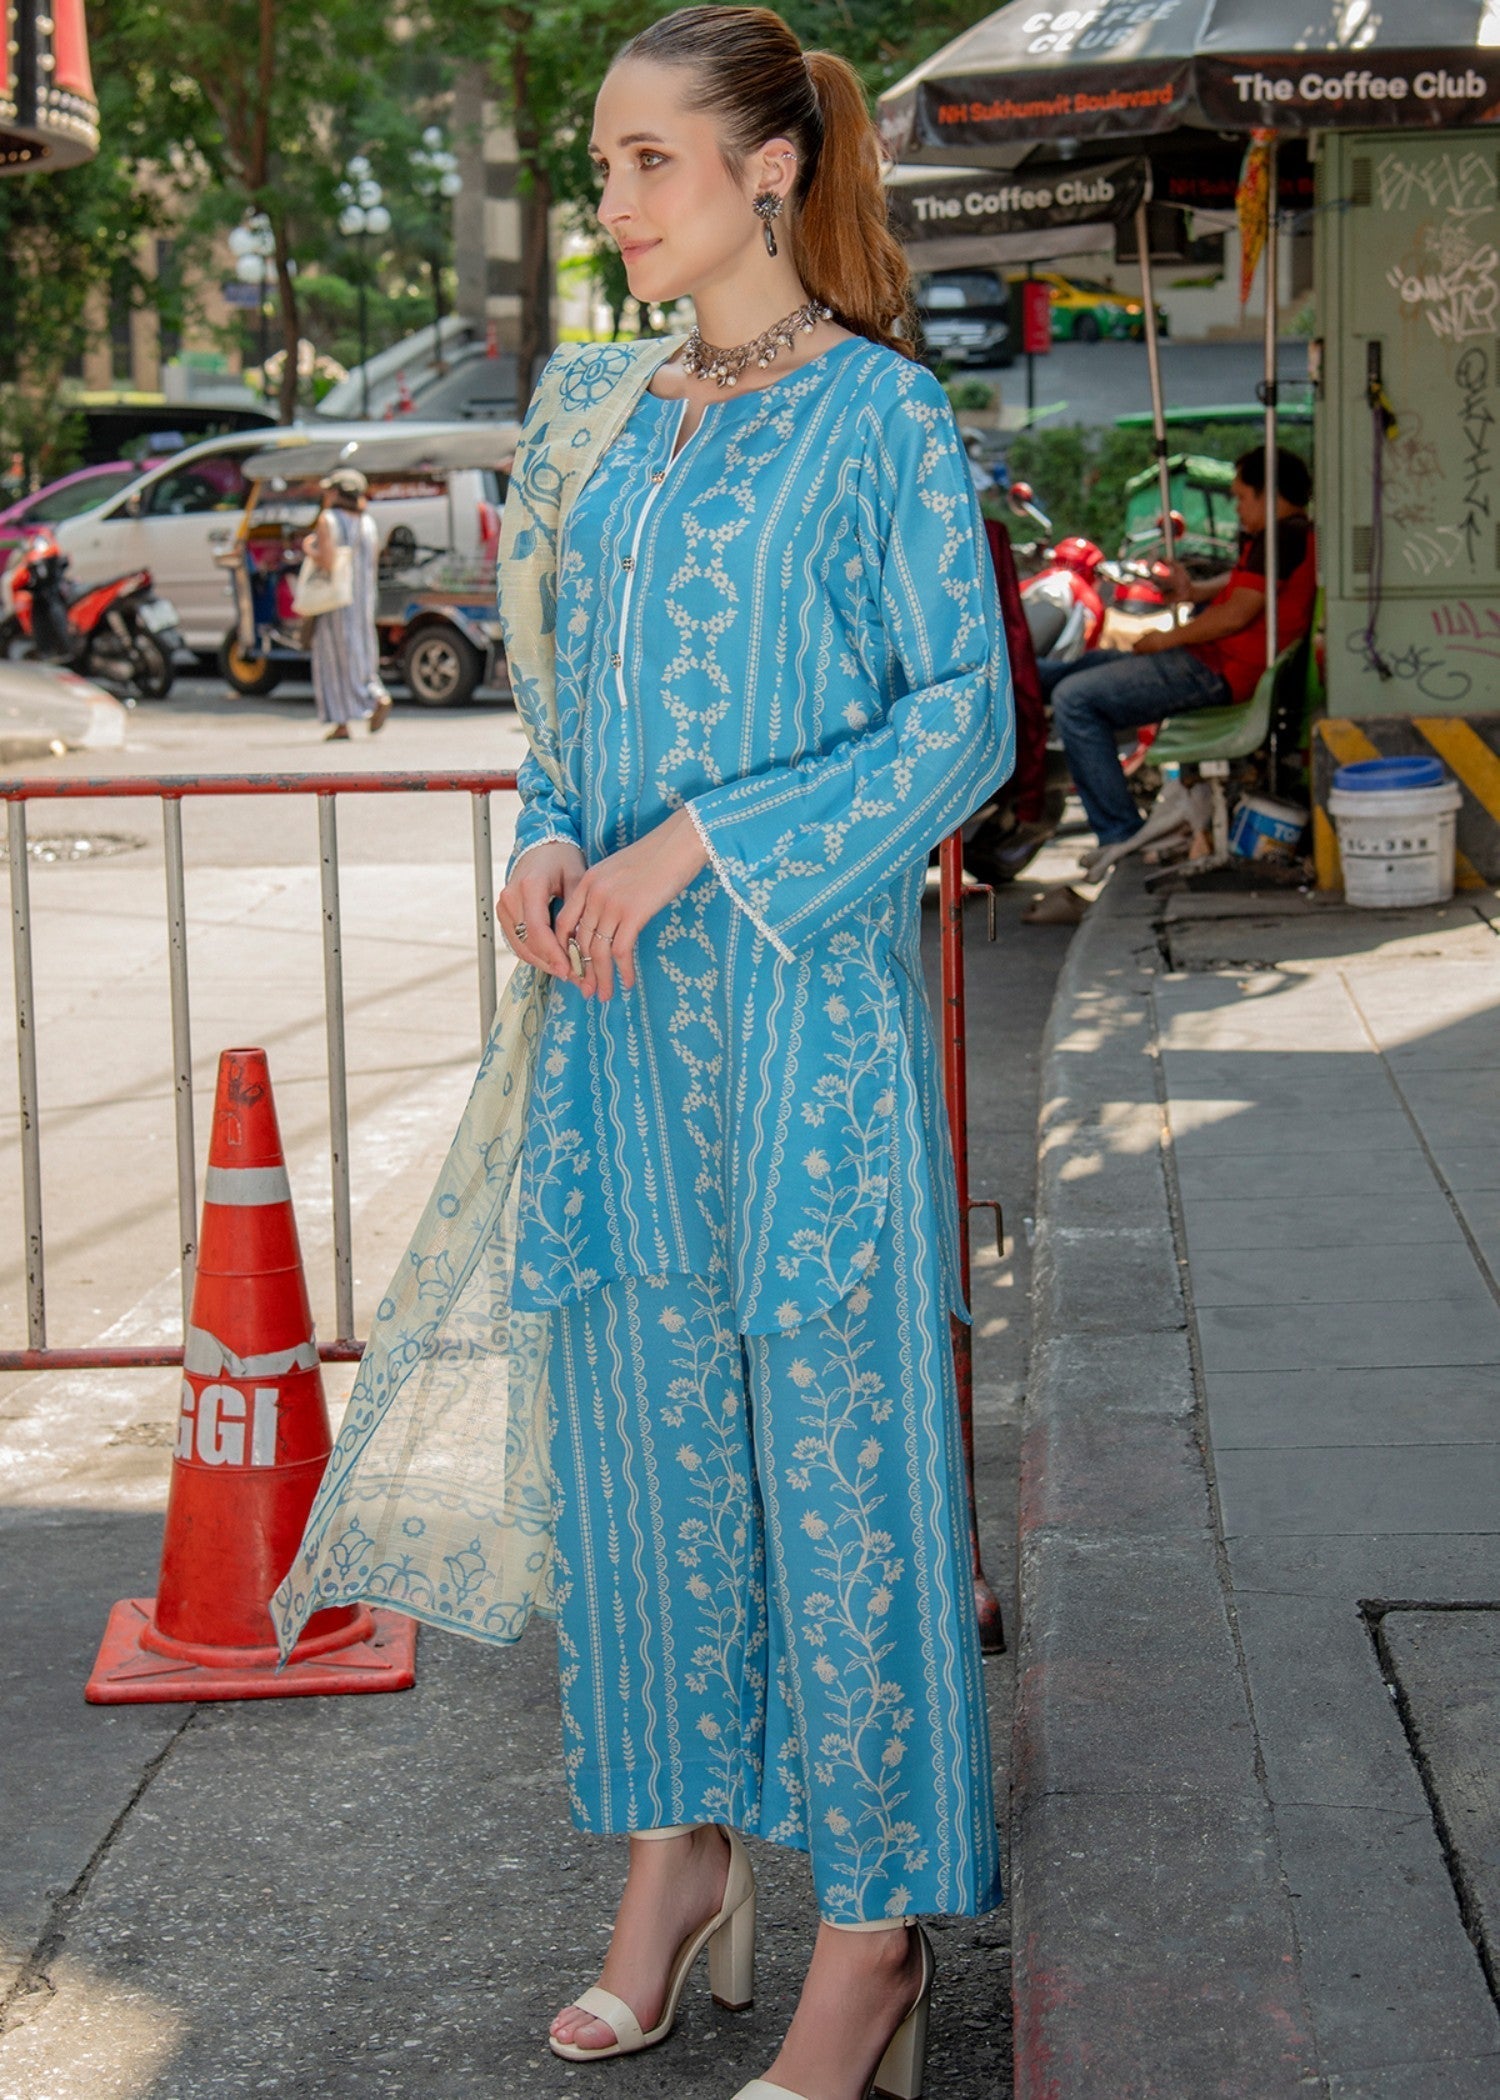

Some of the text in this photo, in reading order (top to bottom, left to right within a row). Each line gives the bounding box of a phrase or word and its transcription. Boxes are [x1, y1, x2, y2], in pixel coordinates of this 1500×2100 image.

[1022, 2, 1182, 34] COFFEE
[1027, 27, 1137, 54] CLUB
[1233, 69, 1487, 101] The Coffee Club
[938, 83, 1173, 124] NH Sukhumvit Boulevard
[912, 177, 1115, 221] The Coffee Club
